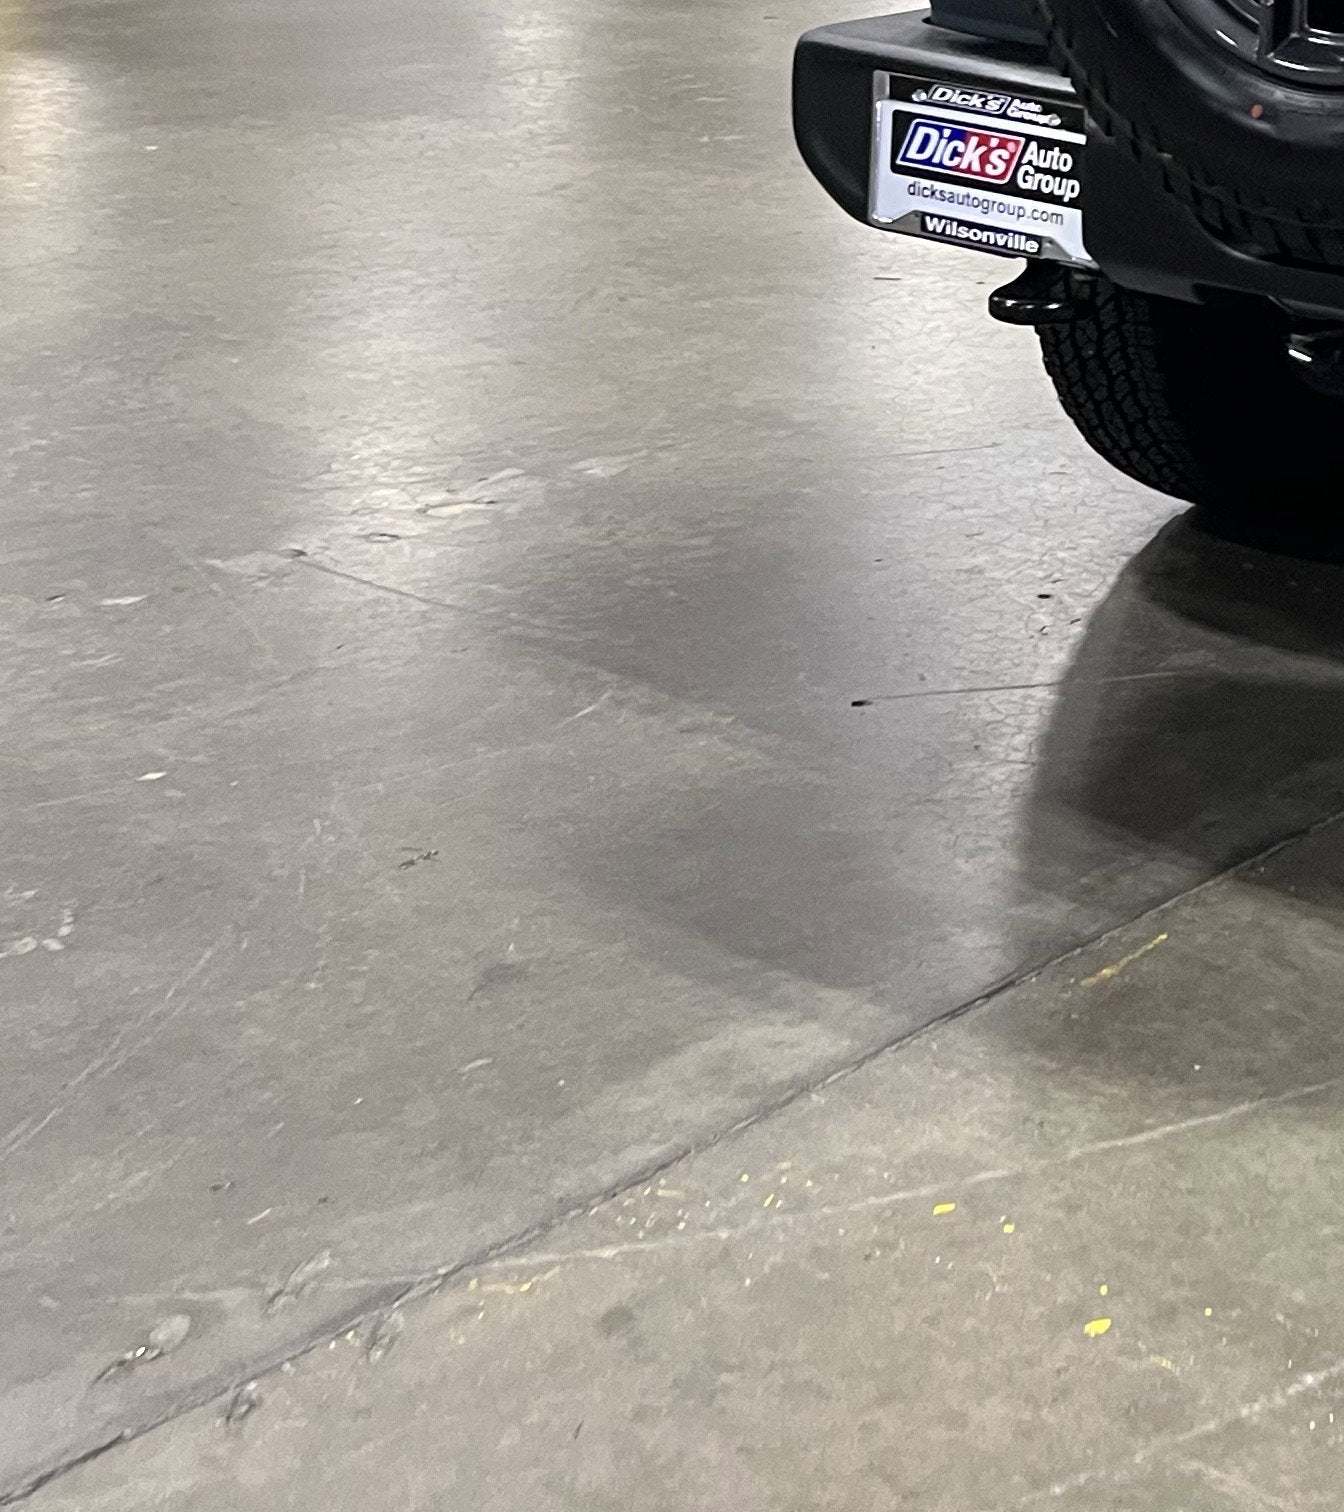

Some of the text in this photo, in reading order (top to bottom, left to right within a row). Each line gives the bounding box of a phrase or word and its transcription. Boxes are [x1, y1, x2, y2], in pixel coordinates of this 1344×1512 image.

[931, 87, 1006, 111] Dick's
[1013, 98, 1043, 113] Auto
[905, 126, 1013, 176] Dick's
[1021, 140, 1073, 173] Auto
[1016, 166, 1081, 202] Group
[907, 180, 1065, 225] dicksautogroup.com
[924, 215, 1040, 254] Wilsonville
